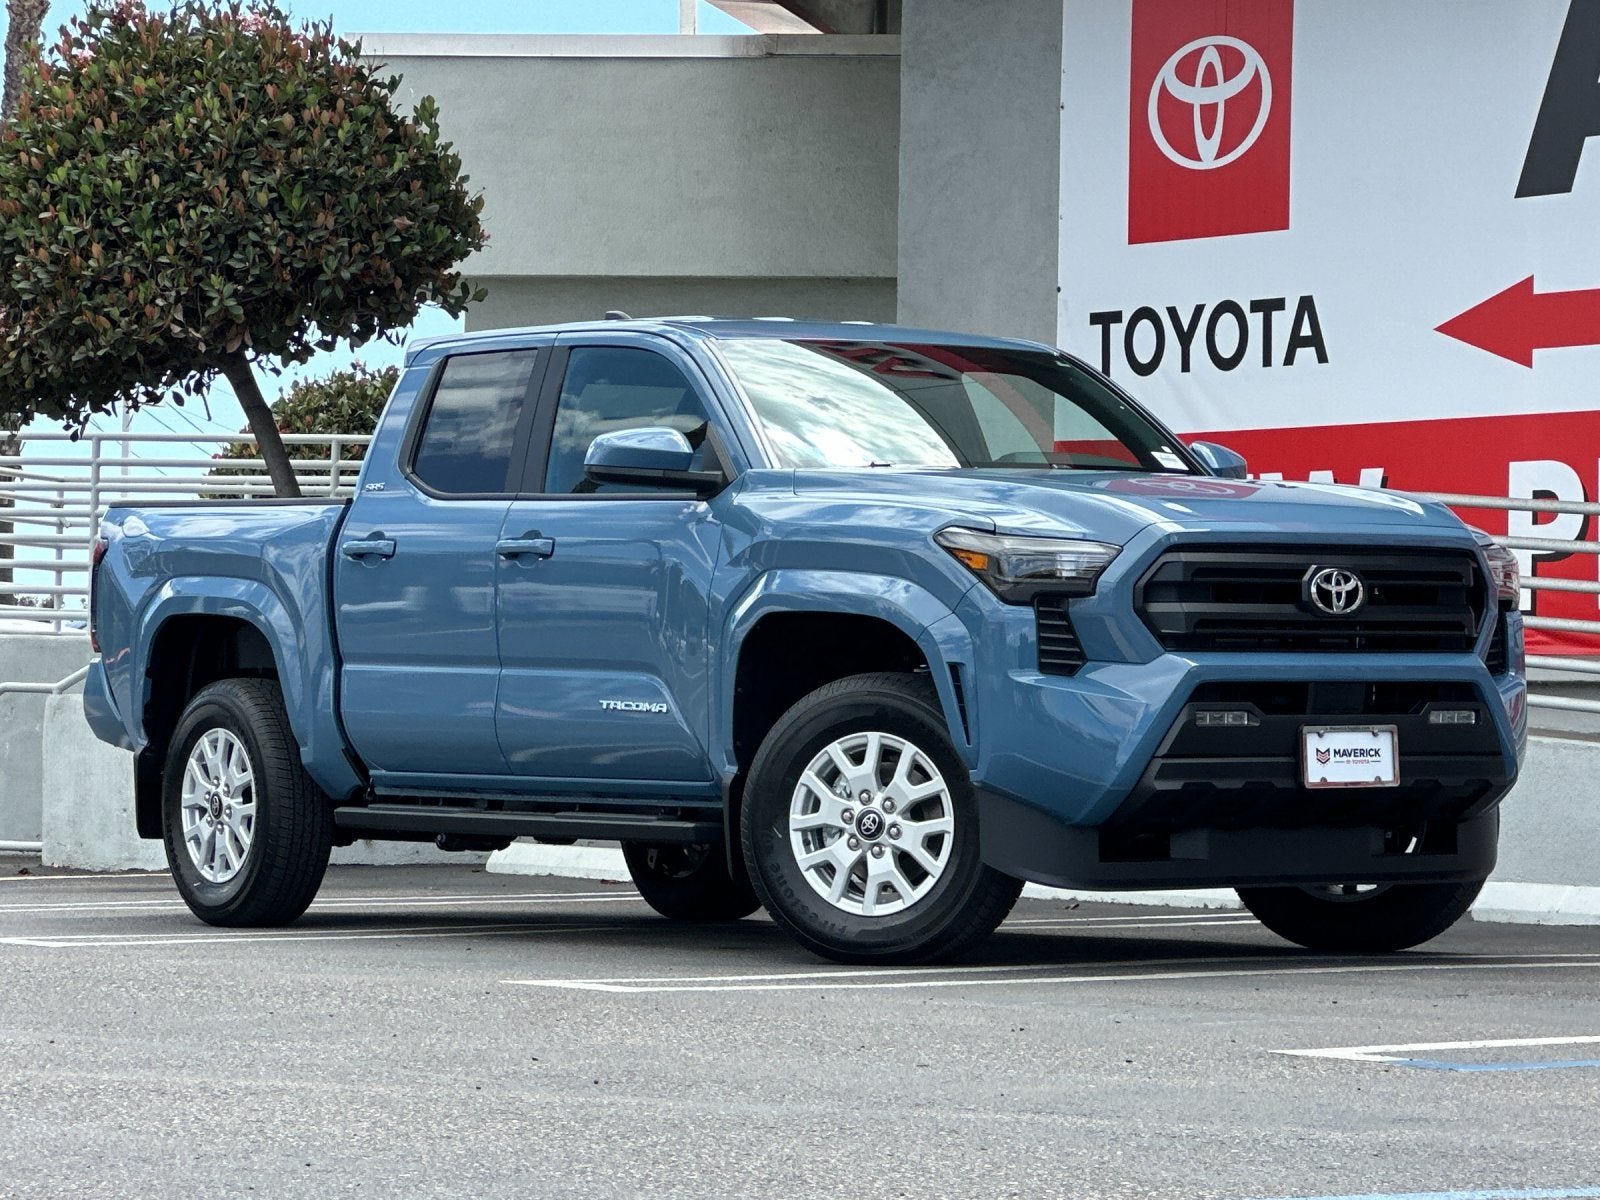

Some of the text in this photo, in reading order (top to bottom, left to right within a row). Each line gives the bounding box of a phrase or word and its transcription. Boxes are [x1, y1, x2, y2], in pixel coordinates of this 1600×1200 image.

[1090, 295, 1329, 377] TOYOTA
[599, 699, 667, 713] TACOMA
[1333, 748, 1381, 758] MAVERICK
